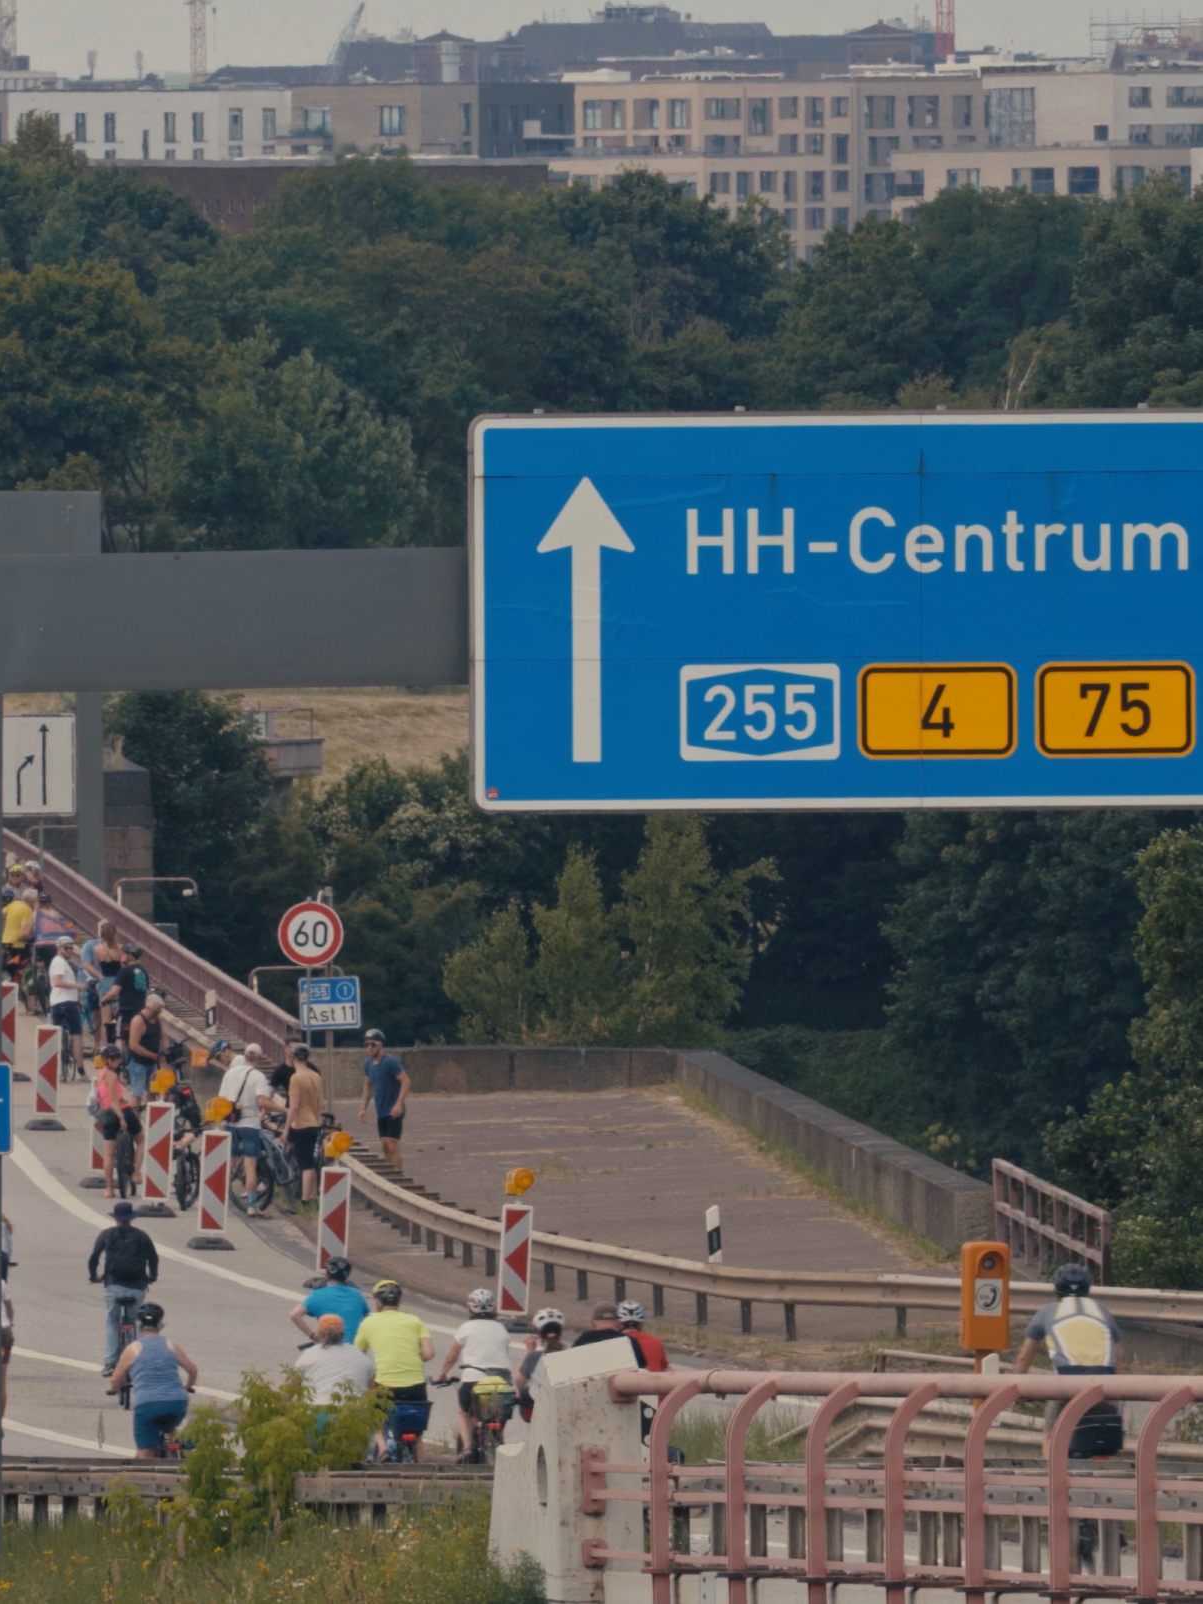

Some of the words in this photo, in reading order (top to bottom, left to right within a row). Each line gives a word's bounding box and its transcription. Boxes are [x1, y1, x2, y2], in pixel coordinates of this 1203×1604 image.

[686, 506, 1189, 575] HH-Centrum
[702, 684, 817, 741] 255
[920, 683, 955, 739] 4
[1079, 682, 1151, 739] 75
[294, 920, 328, 948] 60
[308, 1006, 336, 1022] Ast
[341, 1005, 355, 1021] 11
